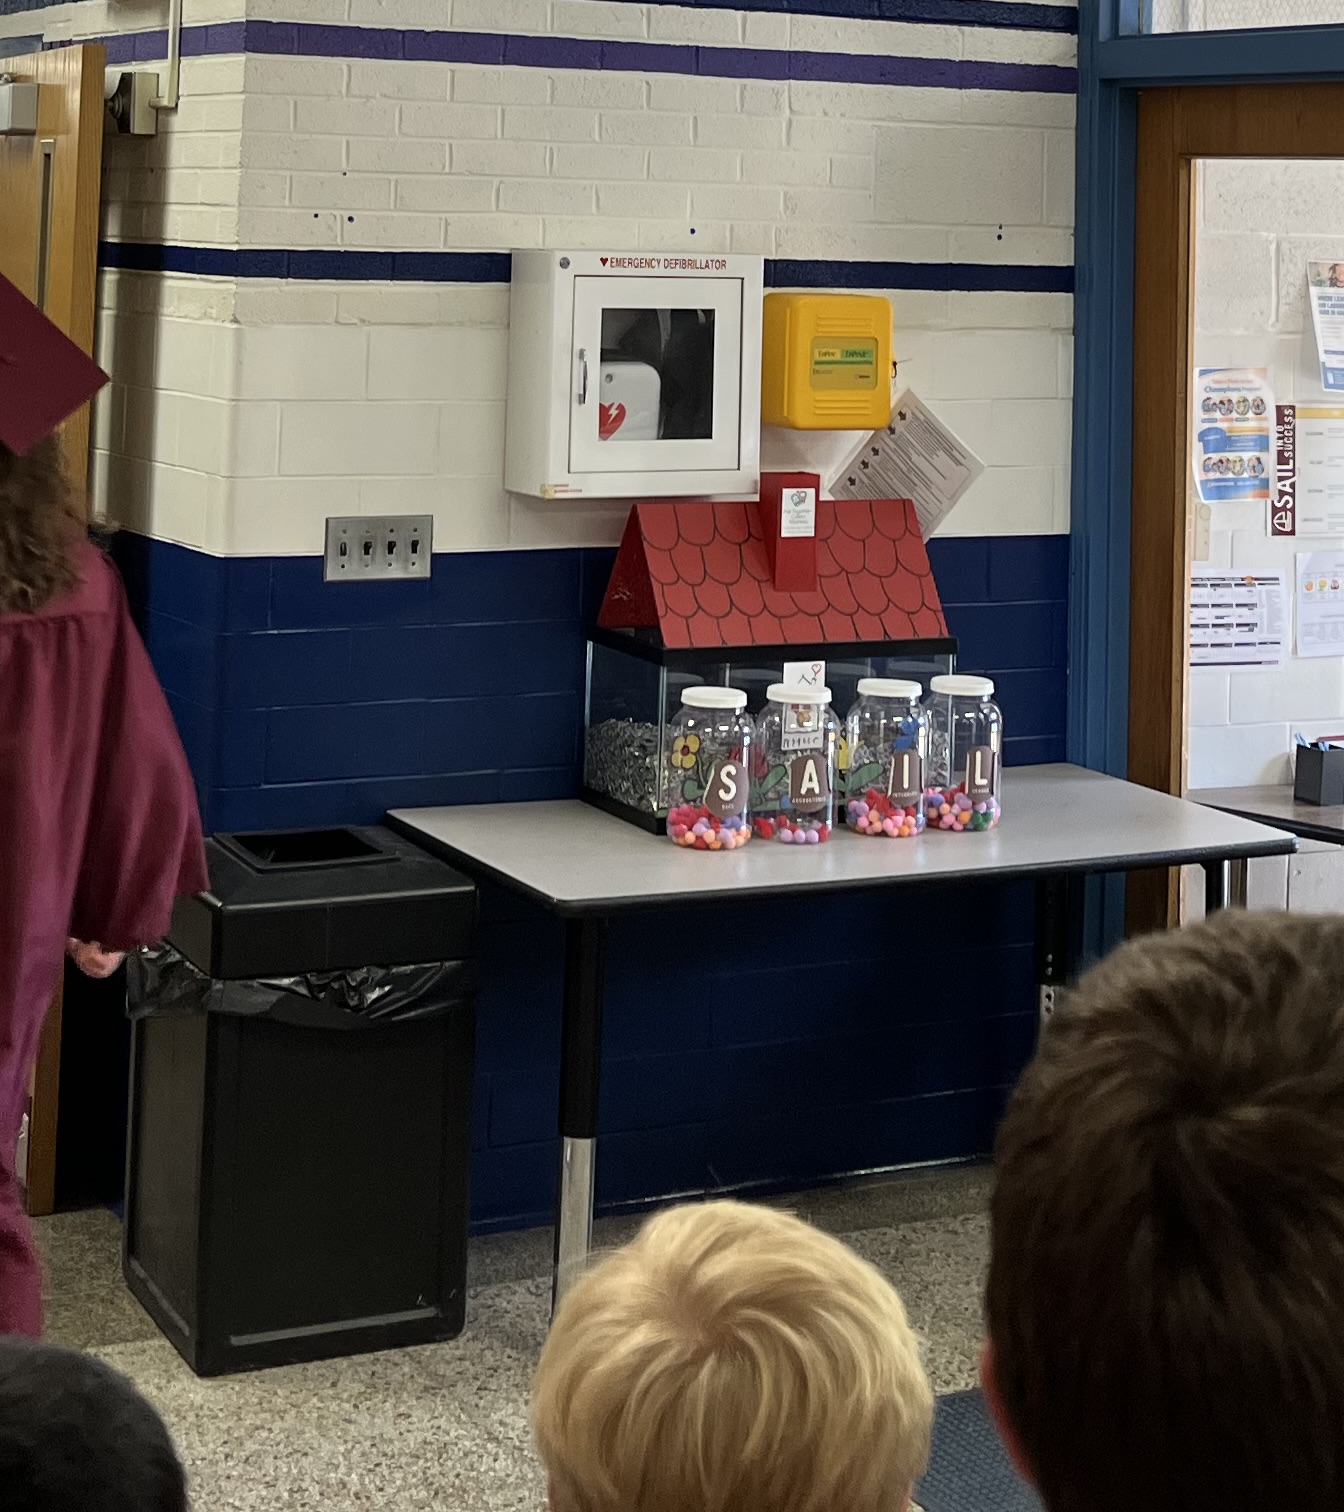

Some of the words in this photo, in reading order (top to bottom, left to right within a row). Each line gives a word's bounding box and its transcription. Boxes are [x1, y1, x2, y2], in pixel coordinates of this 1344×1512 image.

[609, 257, 661, 269] EMERGENCY
[663, 258, 727, 270] DEFIBRILLATOR
[1275, 425, 1284, 451] INTO
[1283, 408, 1294, 458] SUCCESS
[1273, 458, 1296, 509] SAIL
[718, 764, 737, 801] S
[800, 759, 820, 795] A
[903, 753, 909, 789] I
[974, 750, 989, 785] L
